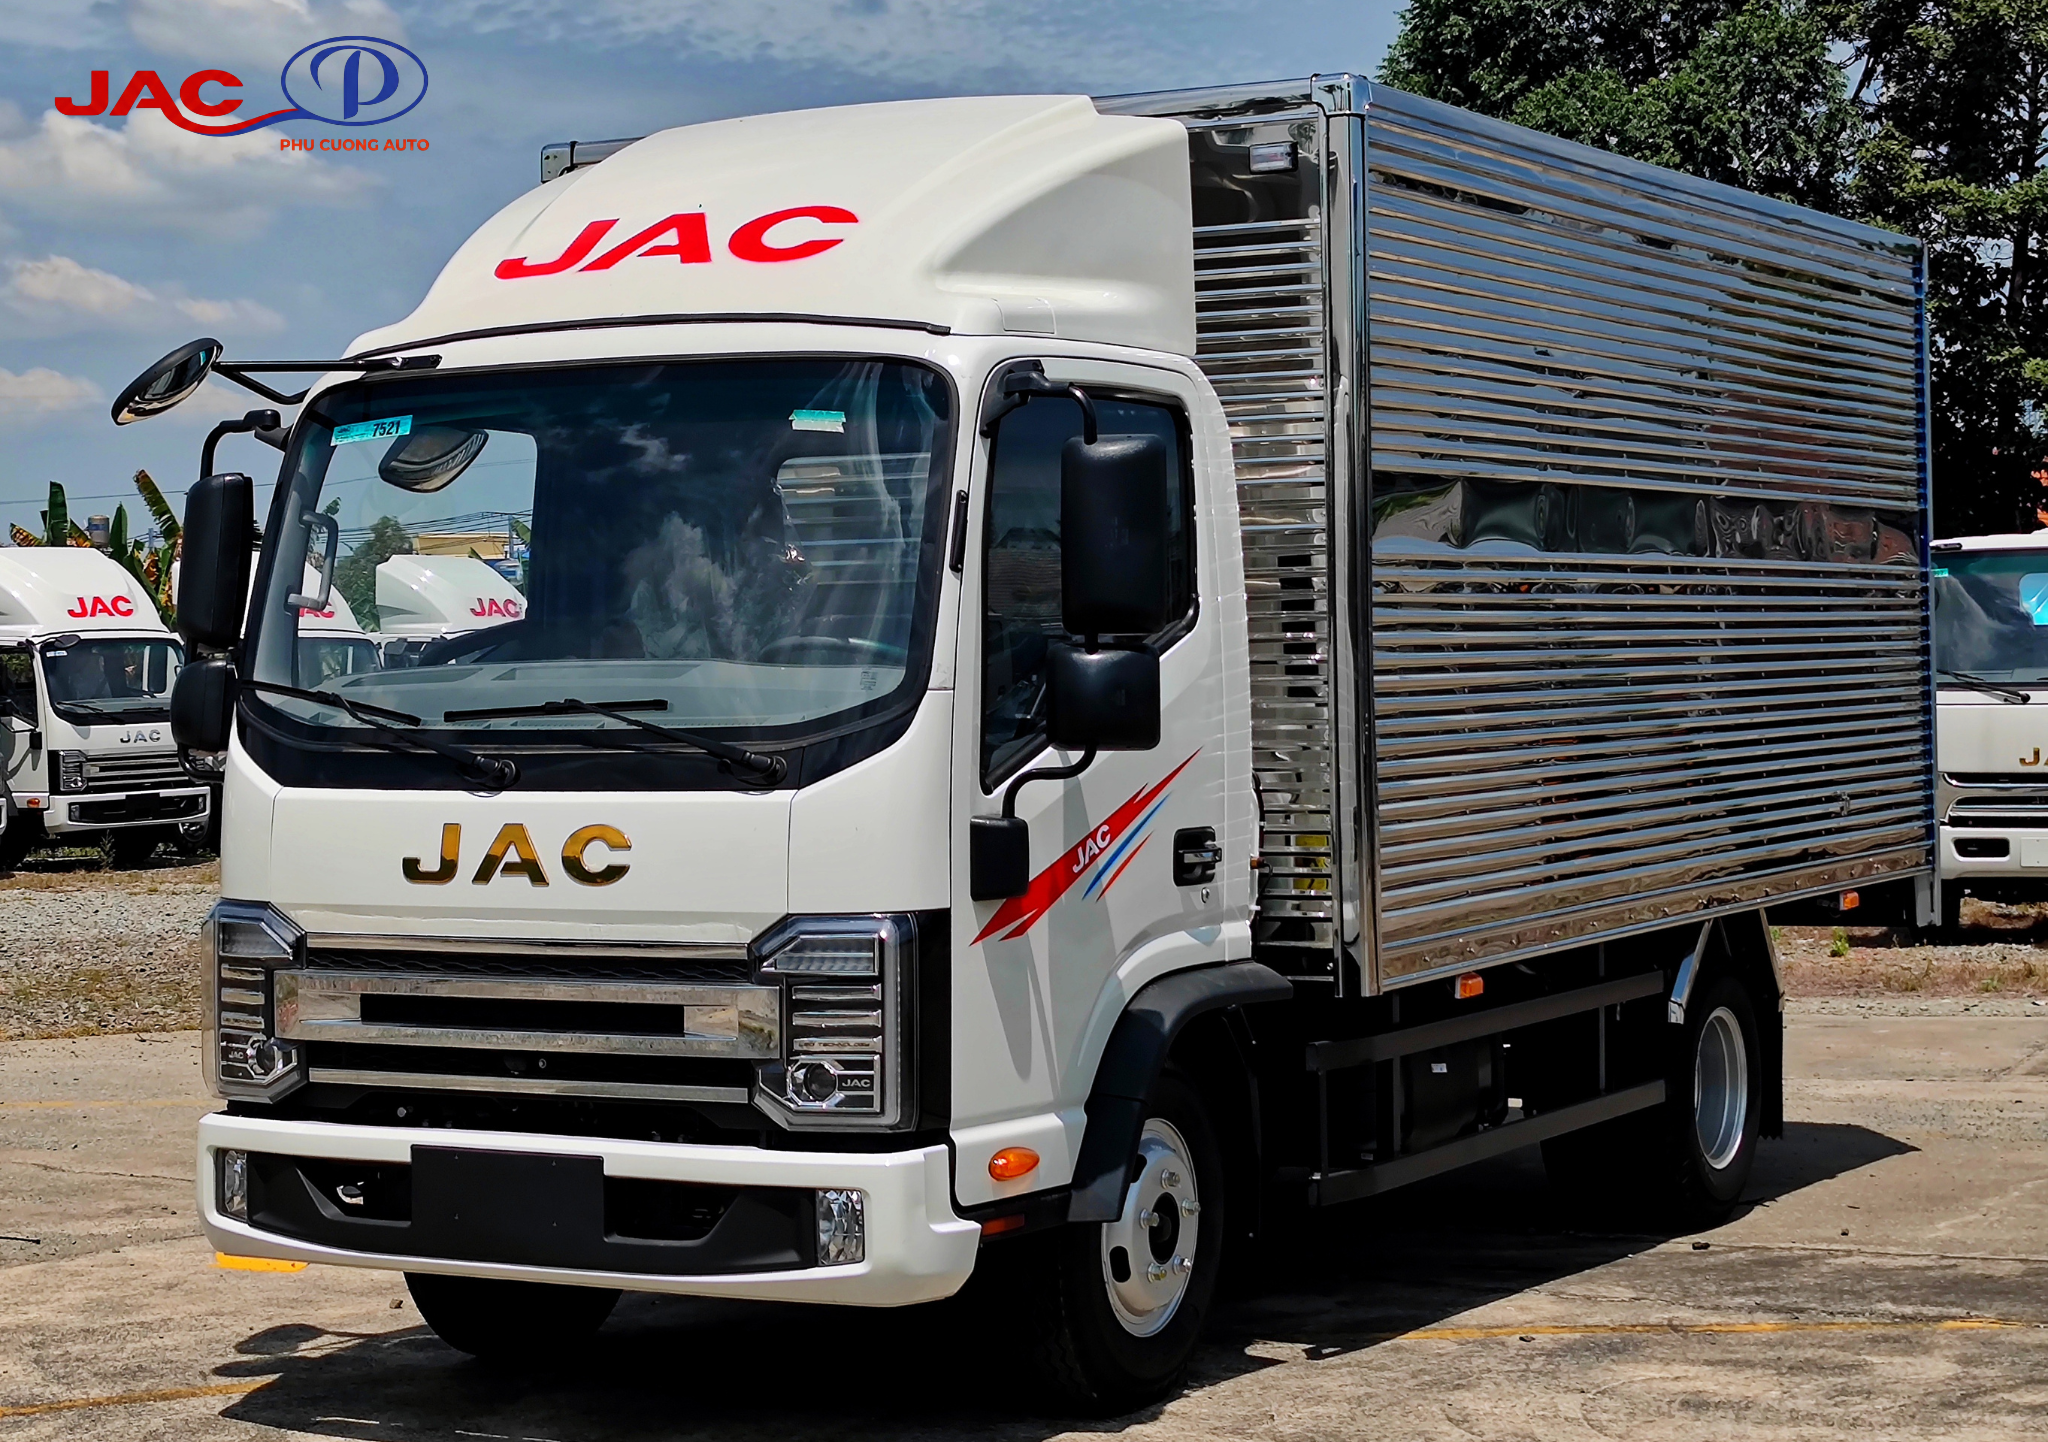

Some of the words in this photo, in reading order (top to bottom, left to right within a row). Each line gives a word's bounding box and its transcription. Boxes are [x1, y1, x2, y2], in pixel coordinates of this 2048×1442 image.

[494, 205, 859, 280] JAC
[372, 420, 401, 437] 7521
[67, 595, 134, 618] JAC
[469, 597, 520, 618] JAC
[120, 729, 161, 743] JAC
[2019, 747, 2048, 767] J
[402, 822, 632, 887] JAC
[1072, 824, 1111, 873] JAC
[842, 1079, 871, 1088] JAC
